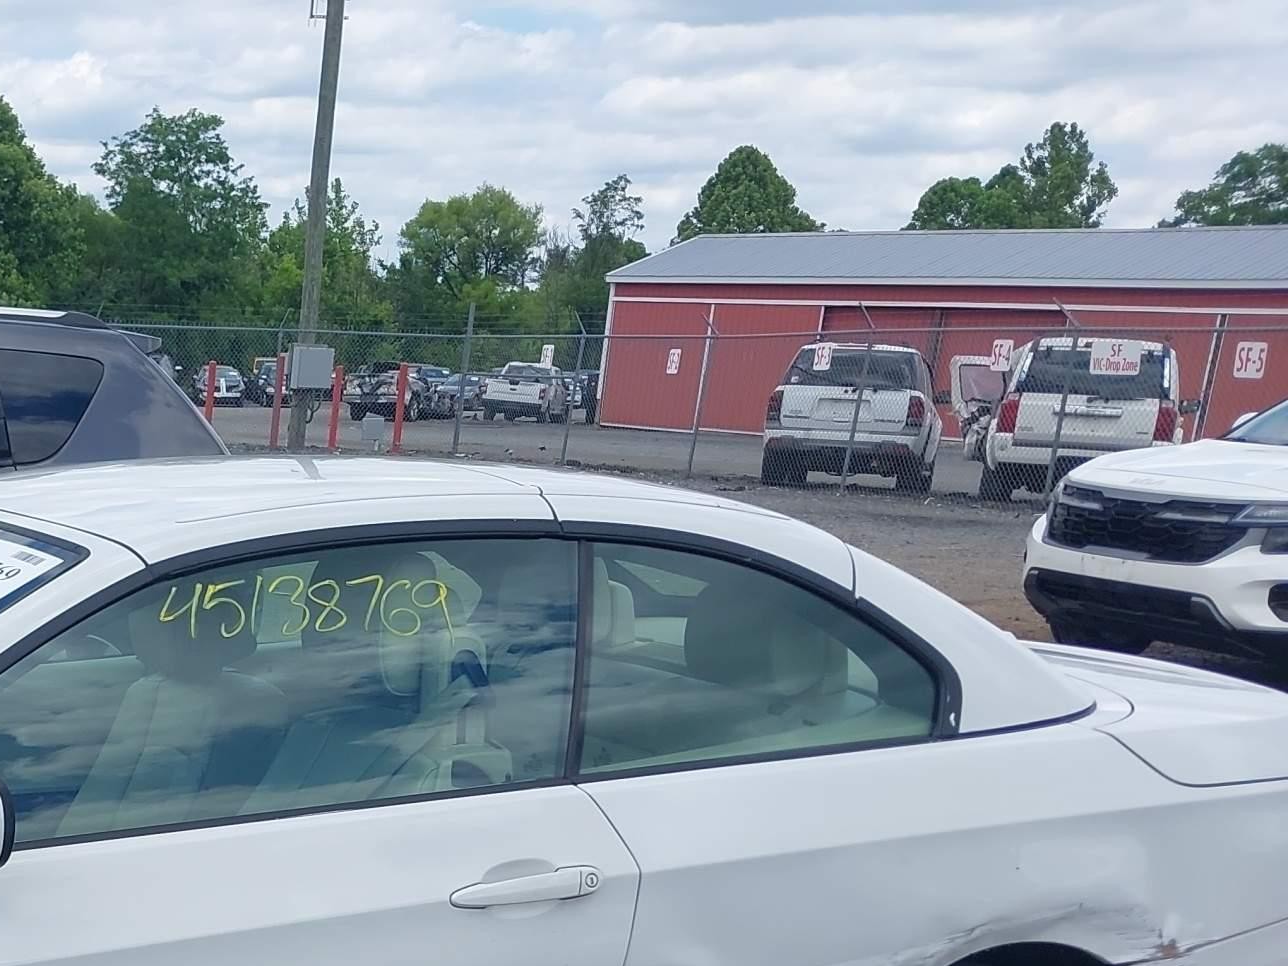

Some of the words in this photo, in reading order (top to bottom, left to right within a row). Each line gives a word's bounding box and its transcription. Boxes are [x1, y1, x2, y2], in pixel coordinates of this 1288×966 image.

[814, 345, 832, 367] SF-3
[991, 343, 1011, 367] SF-4
[1110, 343, 1123, 358] SF
[1236, 346, 1266, 373] SF-5
[1093, 357, 1121, 373] VIC-Drop
[1122, 358, 1138, 372] Zone
[159, 575, 456, 648] 45138769
